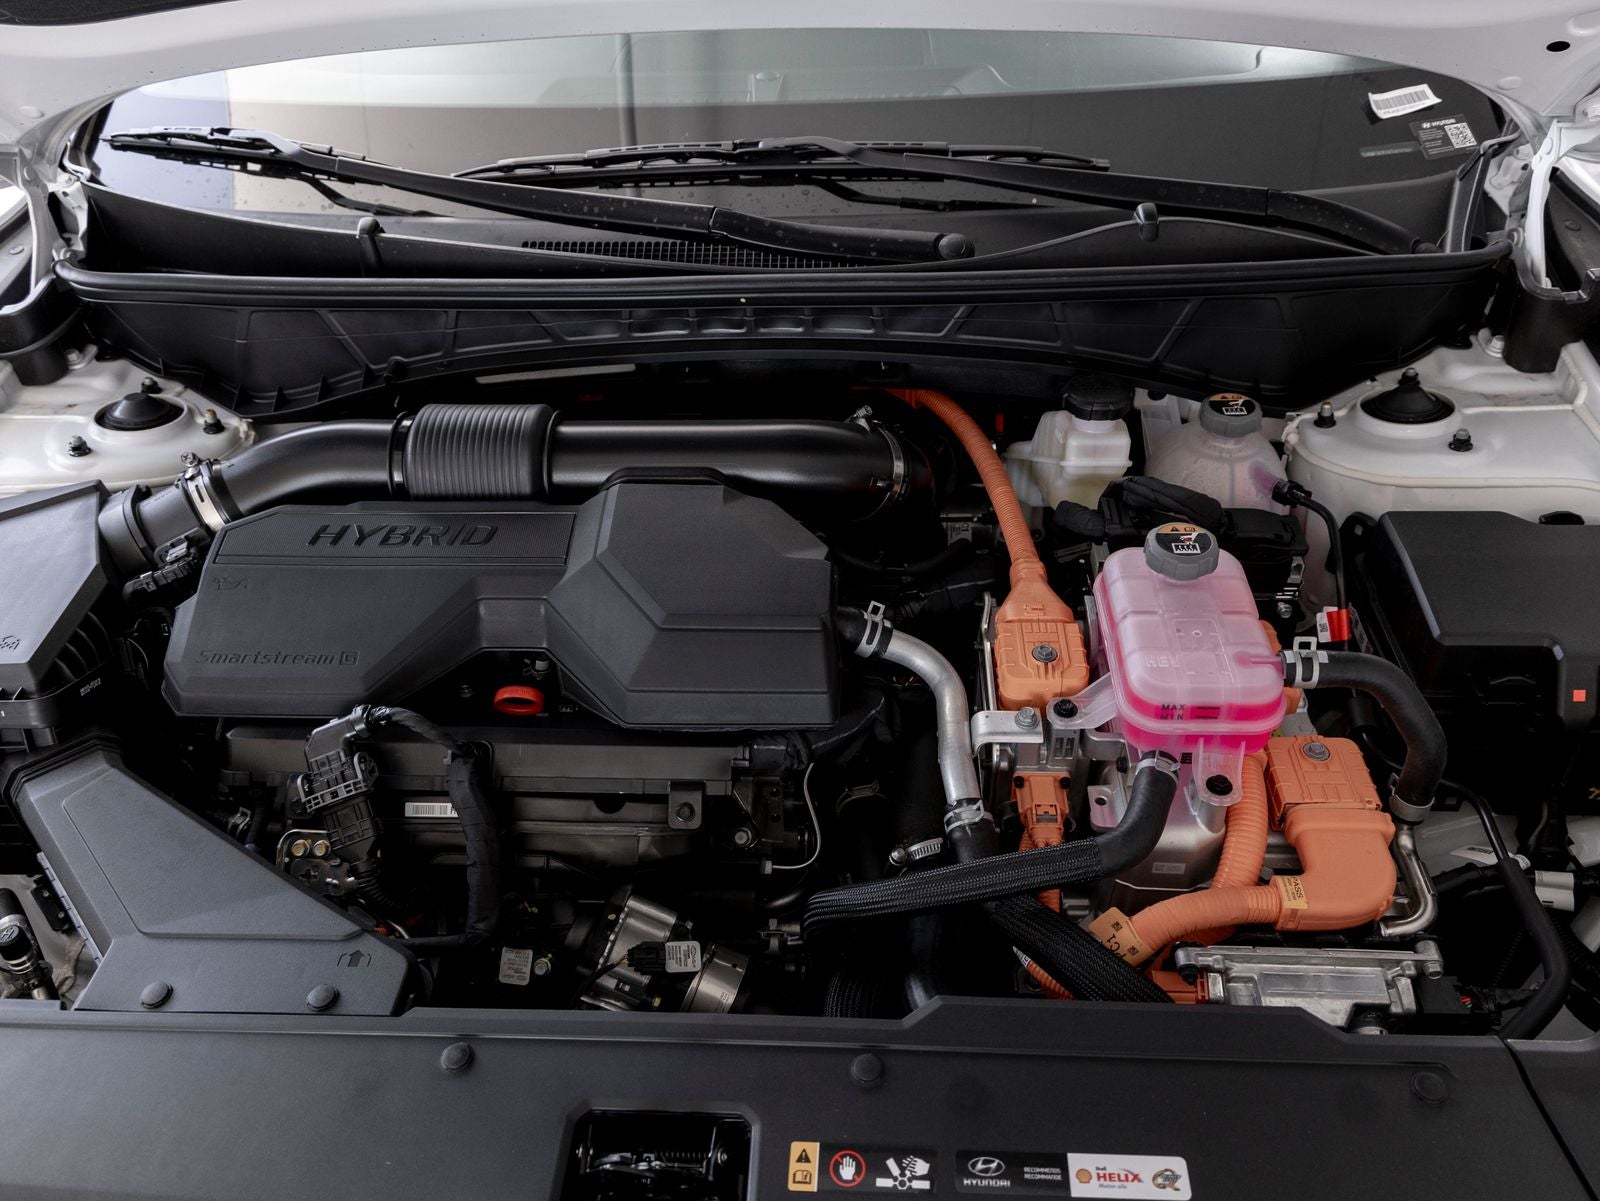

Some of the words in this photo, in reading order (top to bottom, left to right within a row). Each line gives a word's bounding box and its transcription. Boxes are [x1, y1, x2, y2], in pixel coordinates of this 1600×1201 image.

[306, 523, 498, 547] HYBRID
[195, 650, 336, 665] Smartstream
[1291, 876, 1304, 899] PASS
[1024, 1166, 1061, 1174] RECOMMENDS
[963, 1177, 1011, 1188] HYUNDAI
[1024, 1173, 1062, 1181] RECOMMANDE
[1096, 1172, 1143, 1183] HELIX
